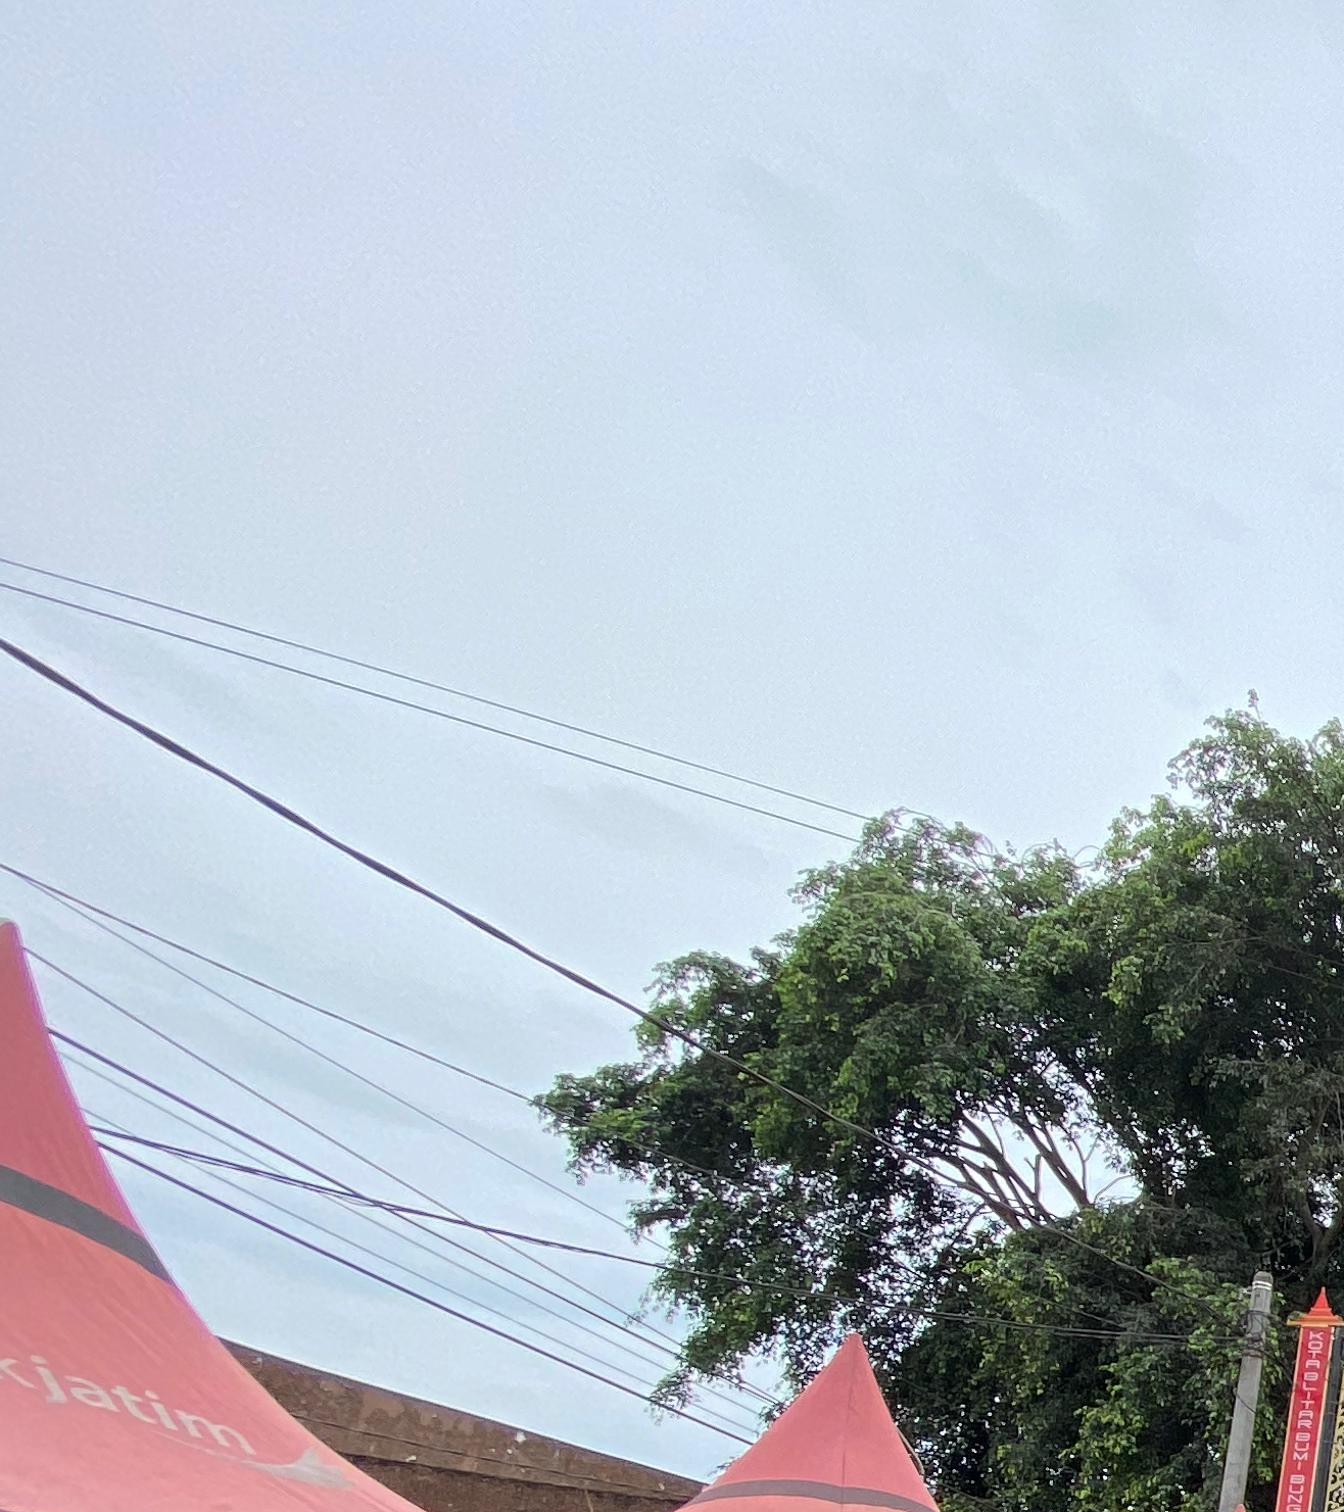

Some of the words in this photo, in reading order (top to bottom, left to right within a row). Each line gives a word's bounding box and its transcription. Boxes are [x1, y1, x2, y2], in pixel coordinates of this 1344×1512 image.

[1304, 1330, 1324, 1369] KOTA
[1297, 1371, 1319, 1429] BLITAR
[1292, 1432, 1311, 1471] BUMI
